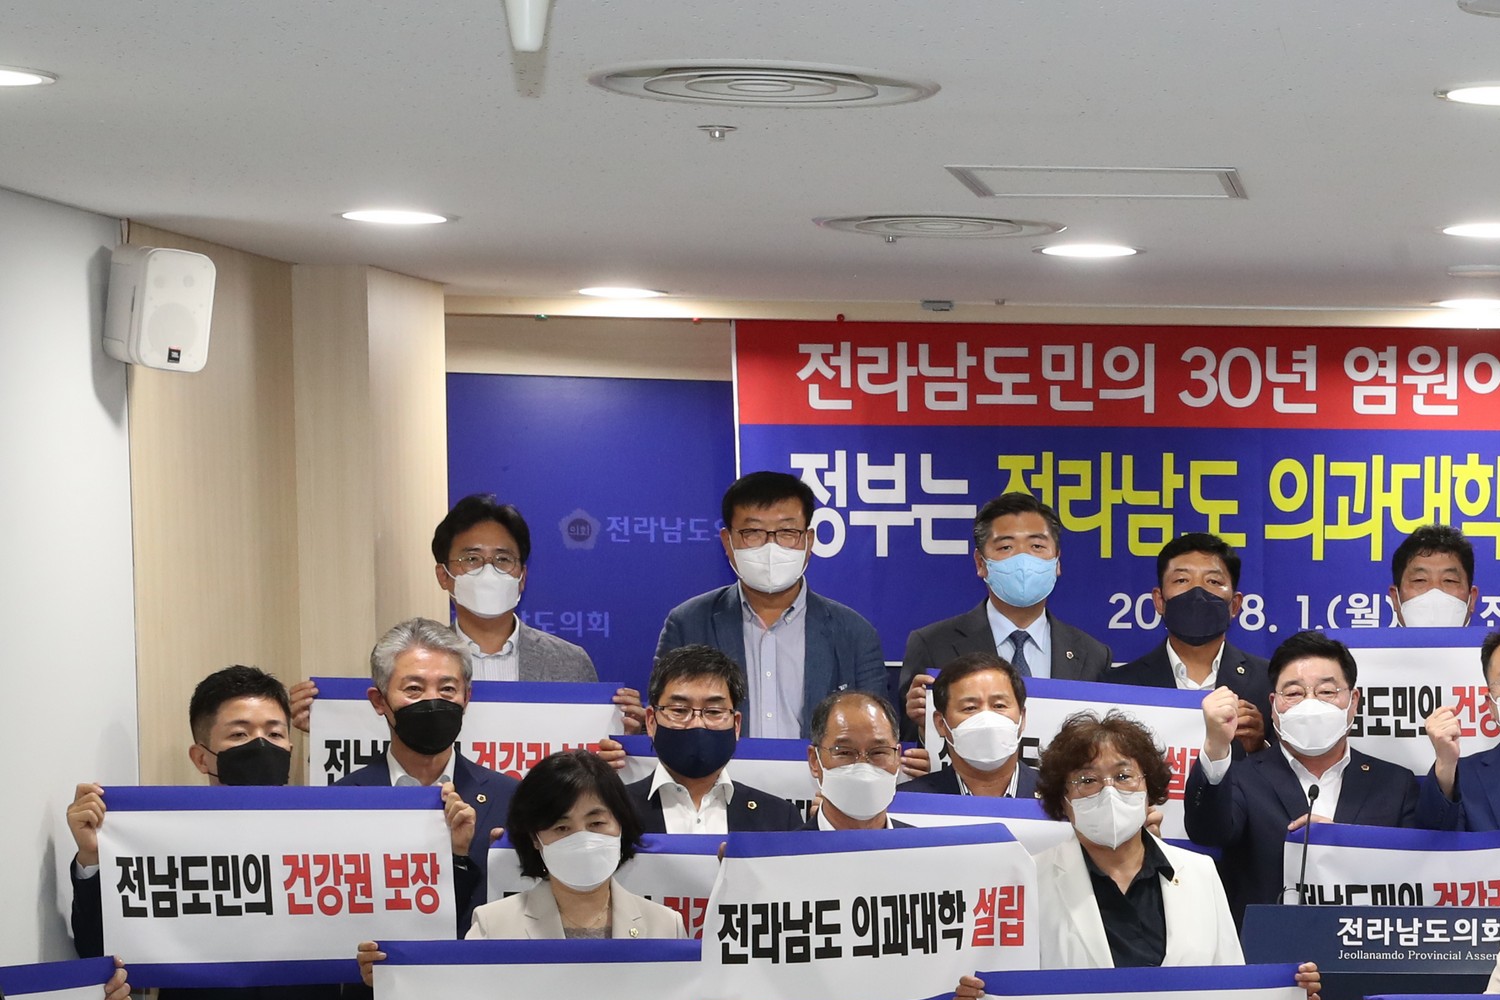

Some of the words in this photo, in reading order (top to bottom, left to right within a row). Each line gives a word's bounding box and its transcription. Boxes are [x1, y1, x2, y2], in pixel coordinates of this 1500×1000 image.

[797, 341, 1155, 414] 전라남도민의
[1180, 344, 1318, 414] 30년
[790, 450, 977, 558] 정부는
[117, 855, 274, 918] 전남도민의
[282, 853, 374, 916] 건강권
[383, 853, 441, 916] 보장
[717, 895, 843, 965] 전라남도
[852, 891, 967, 958] 의과대학
[971, 885, 1025, 948] 설립
[1338, 949, 1405, 960] Jeollanamdo
[1408, 950, 1462, 961] Provincial
